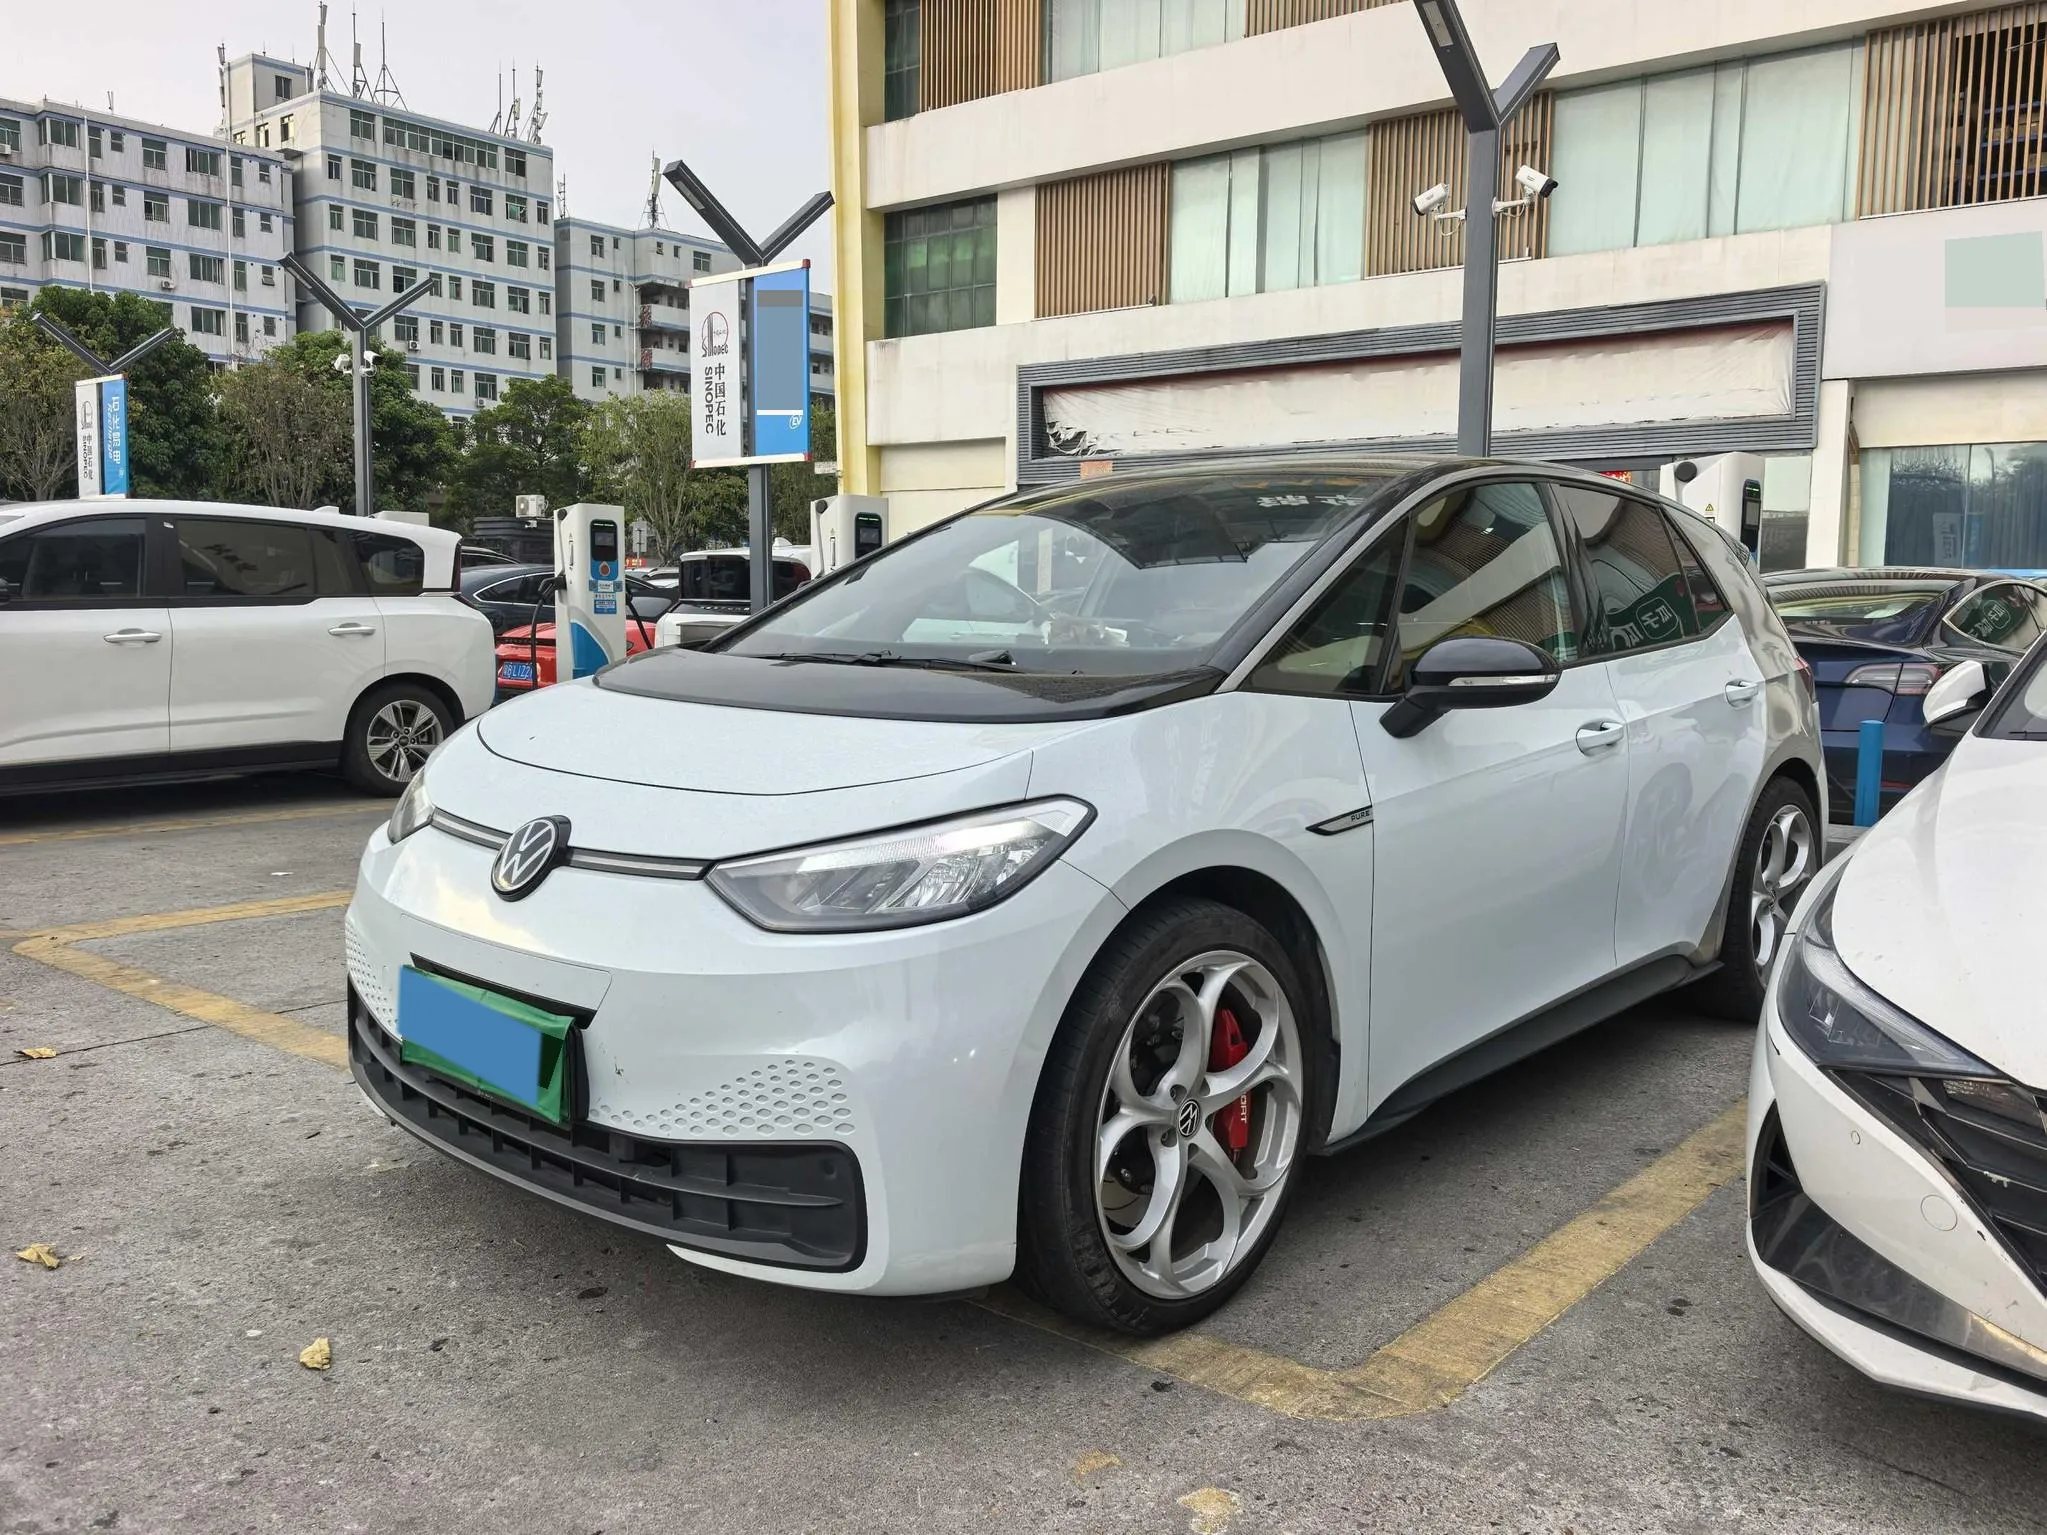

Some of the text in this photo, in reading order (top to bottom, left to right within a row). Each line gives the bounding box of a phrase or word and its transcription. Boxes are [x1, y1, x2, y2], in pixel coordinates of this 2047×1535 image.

[704, 366, 714, 434] SINOPEC
[714, 362, 727, 437] 中国石化
[1350, 810, 1370, 822] PURE
